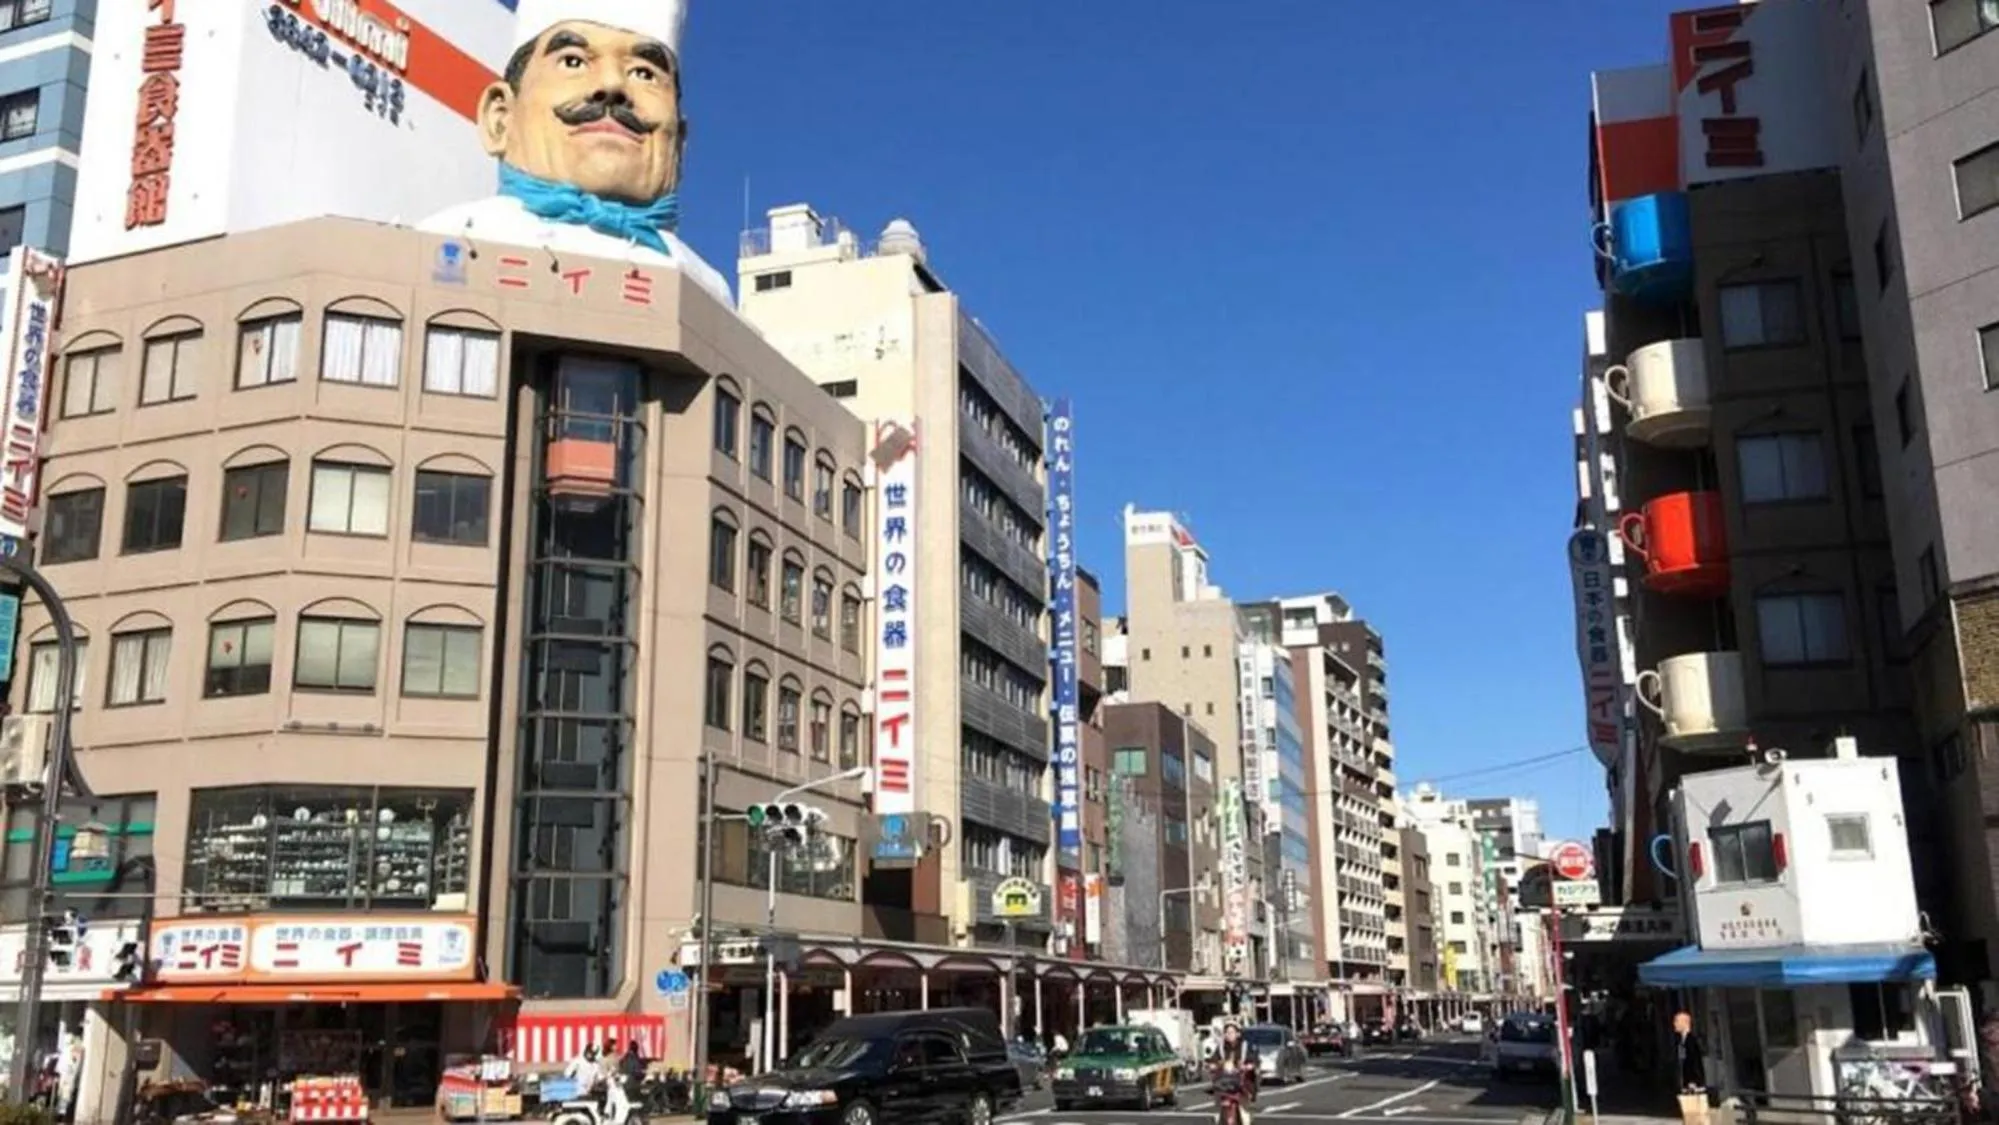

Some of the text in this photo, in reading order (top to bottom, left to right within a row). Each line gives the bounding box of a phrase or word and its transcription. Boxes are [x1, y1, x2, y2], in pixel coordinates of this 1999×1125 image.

[1691, 9, 1765, 168] ニイミ
[498, 258, 653, 304] ニイミ
[1, 301, 47, 520] 世界の食器 ニイミ
[880, 483, 910, 793] 世界の食器 ニイミ
[1590, 671, 1618, 745] ニイミ
[177, 943, 242, 970] ニイミ
[272, 942, 423, 967] ニイミ
